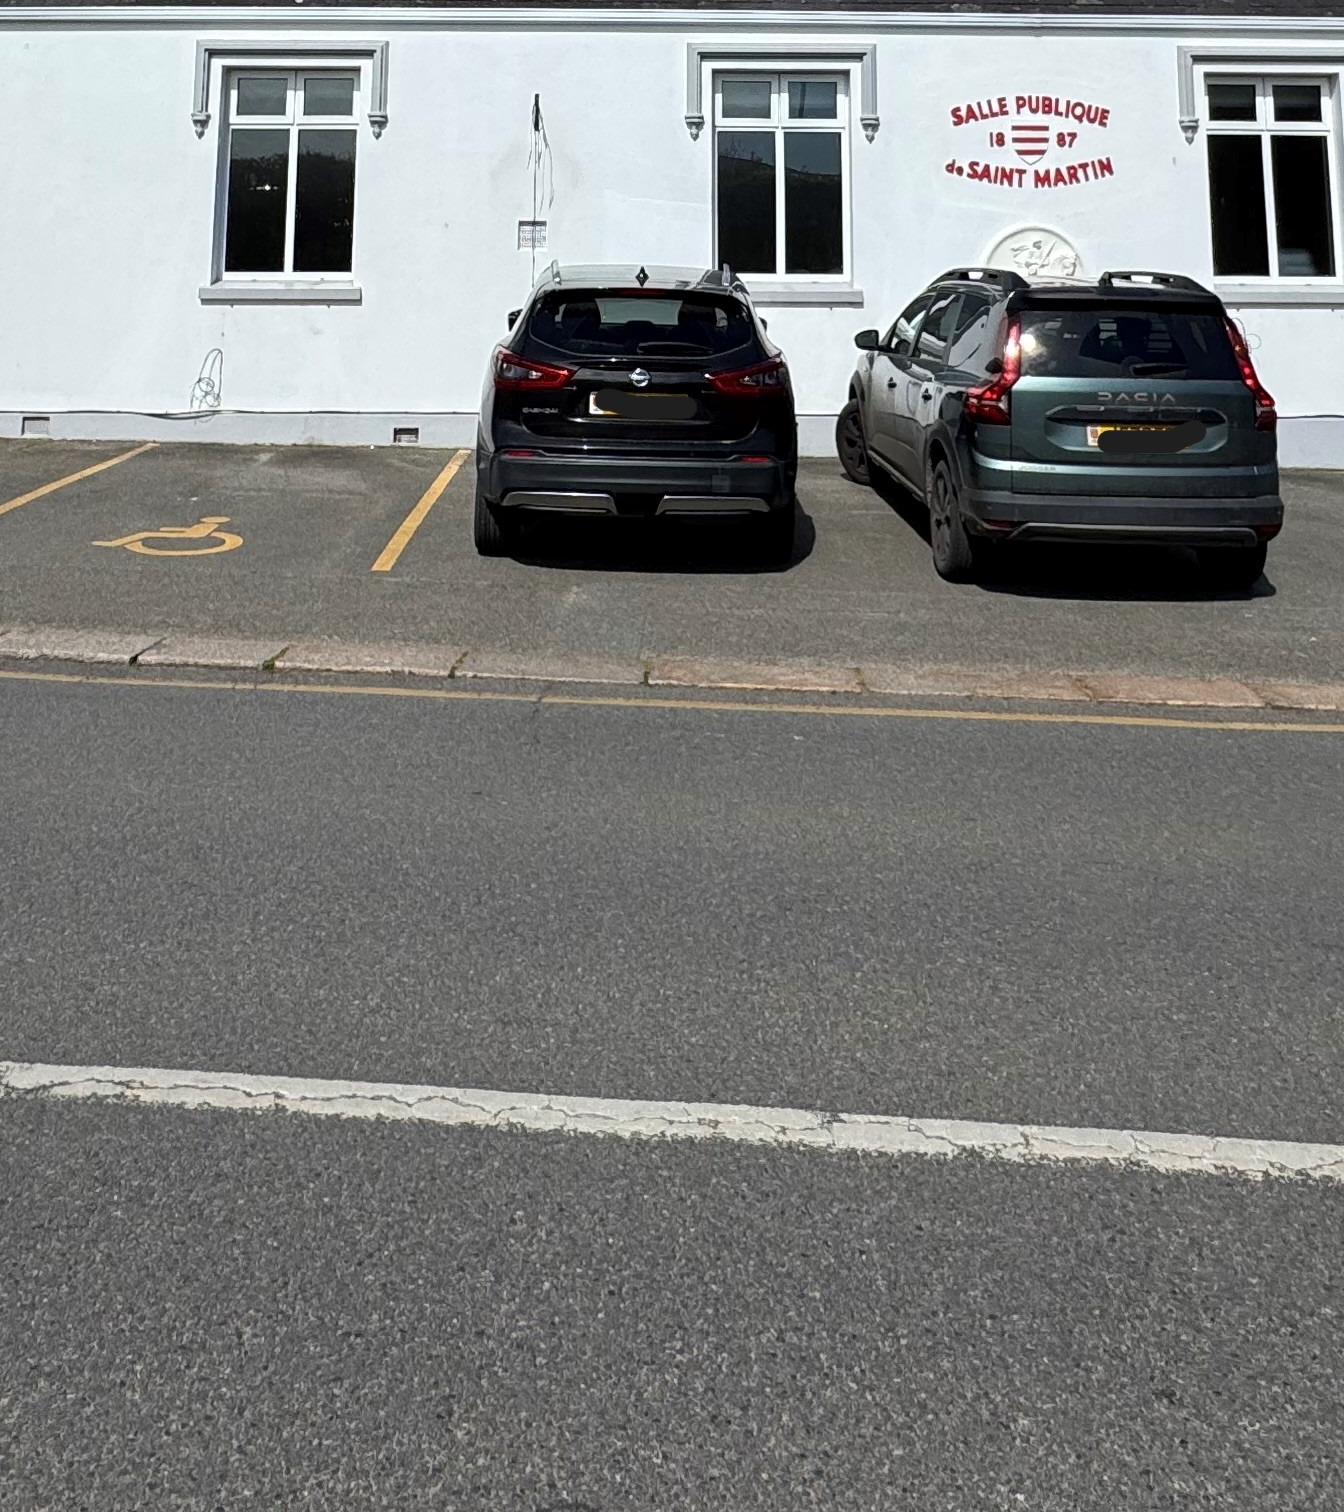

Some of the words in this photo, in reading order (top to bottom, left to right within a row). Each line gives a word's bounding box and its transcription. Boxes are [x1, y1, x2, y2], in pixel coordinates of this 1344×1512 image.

[950, 96, 1010, 127] SALLE
[1015, 95, 1111, 129] PUBLIQUE
[989, 132, 1006, 148] 18
[1056, 132, 1078, 149] 87
[945, 159, 964, 177] de
[966, 161, 1027, 189] SAINT
[1033, 157, 1115, 189] MARTIN
[1097, 391, 1176, 403] DACIA
